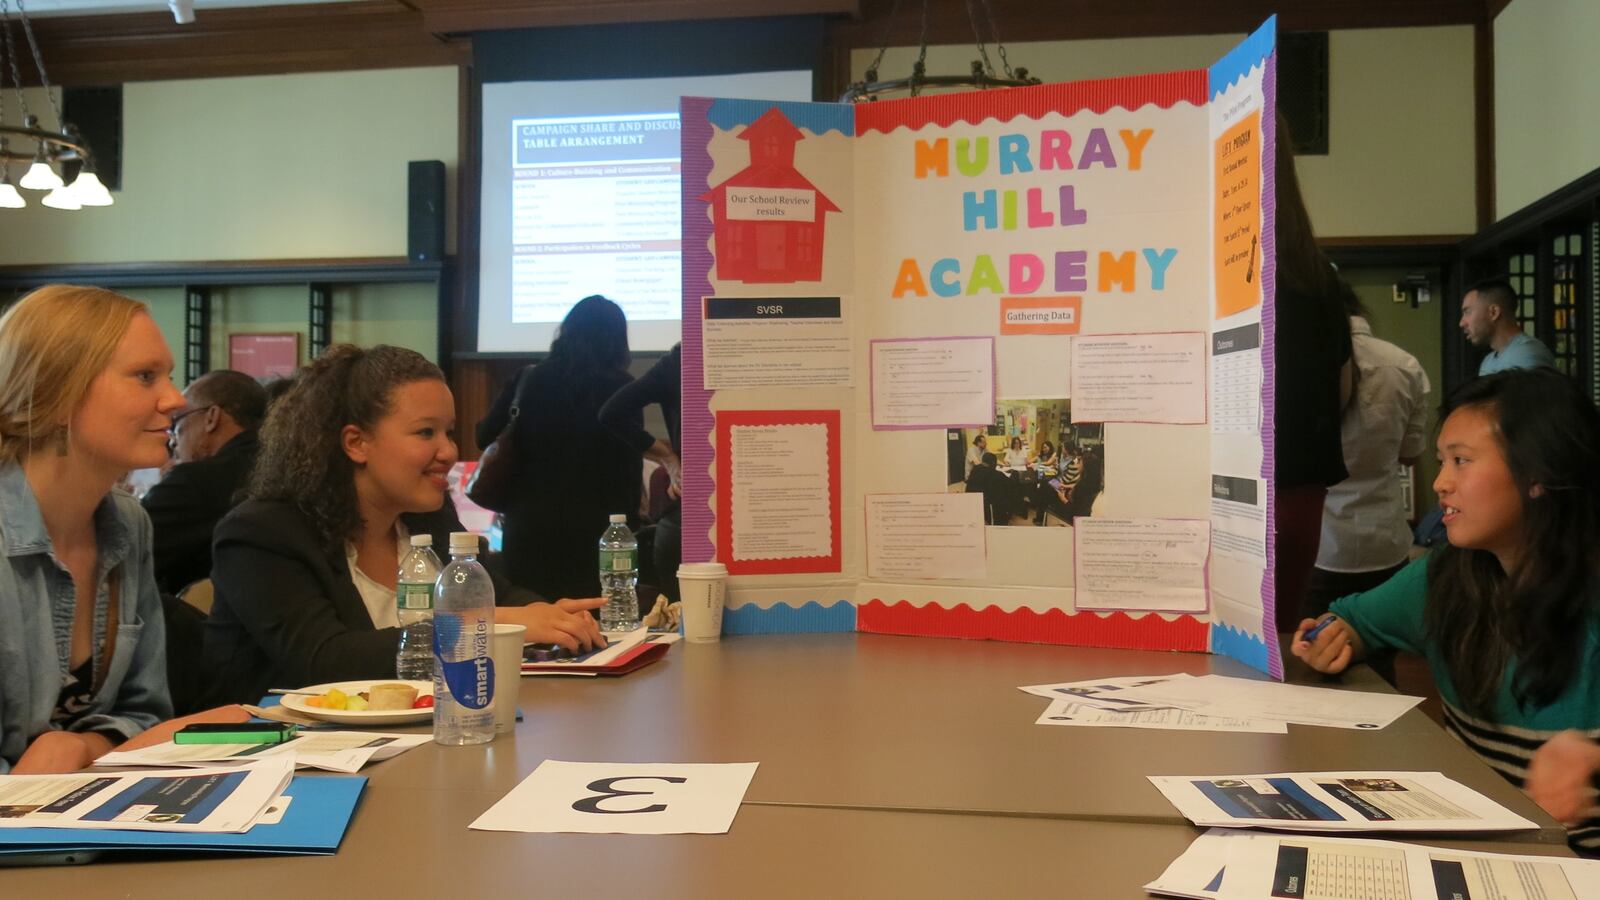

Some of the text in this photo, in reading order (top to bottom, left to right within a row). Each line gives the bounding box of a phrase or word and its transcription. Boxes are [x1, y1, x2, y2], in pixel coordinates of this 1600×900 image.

[522, 124, 577, 136] CAMPAIGN
[580, 123, 615, 134] SHARE
[618, 121, 642, 132] AND
[522, 134, 645, 149] TABLE ARRANGEMENT
[914, 127, 1154, 178] MURRAY
[731, 195, 810, 205] Our School Review
[756, 208, 785, 216] results
[963, 185, 1087, 231] HILL
[892, 248, 1178, 298] ACADEMY
[756, 305, 784, 315] SVSR
[1006, 310, 1071, 323] Gathering Data
[571, 776, 688, 814] 3
